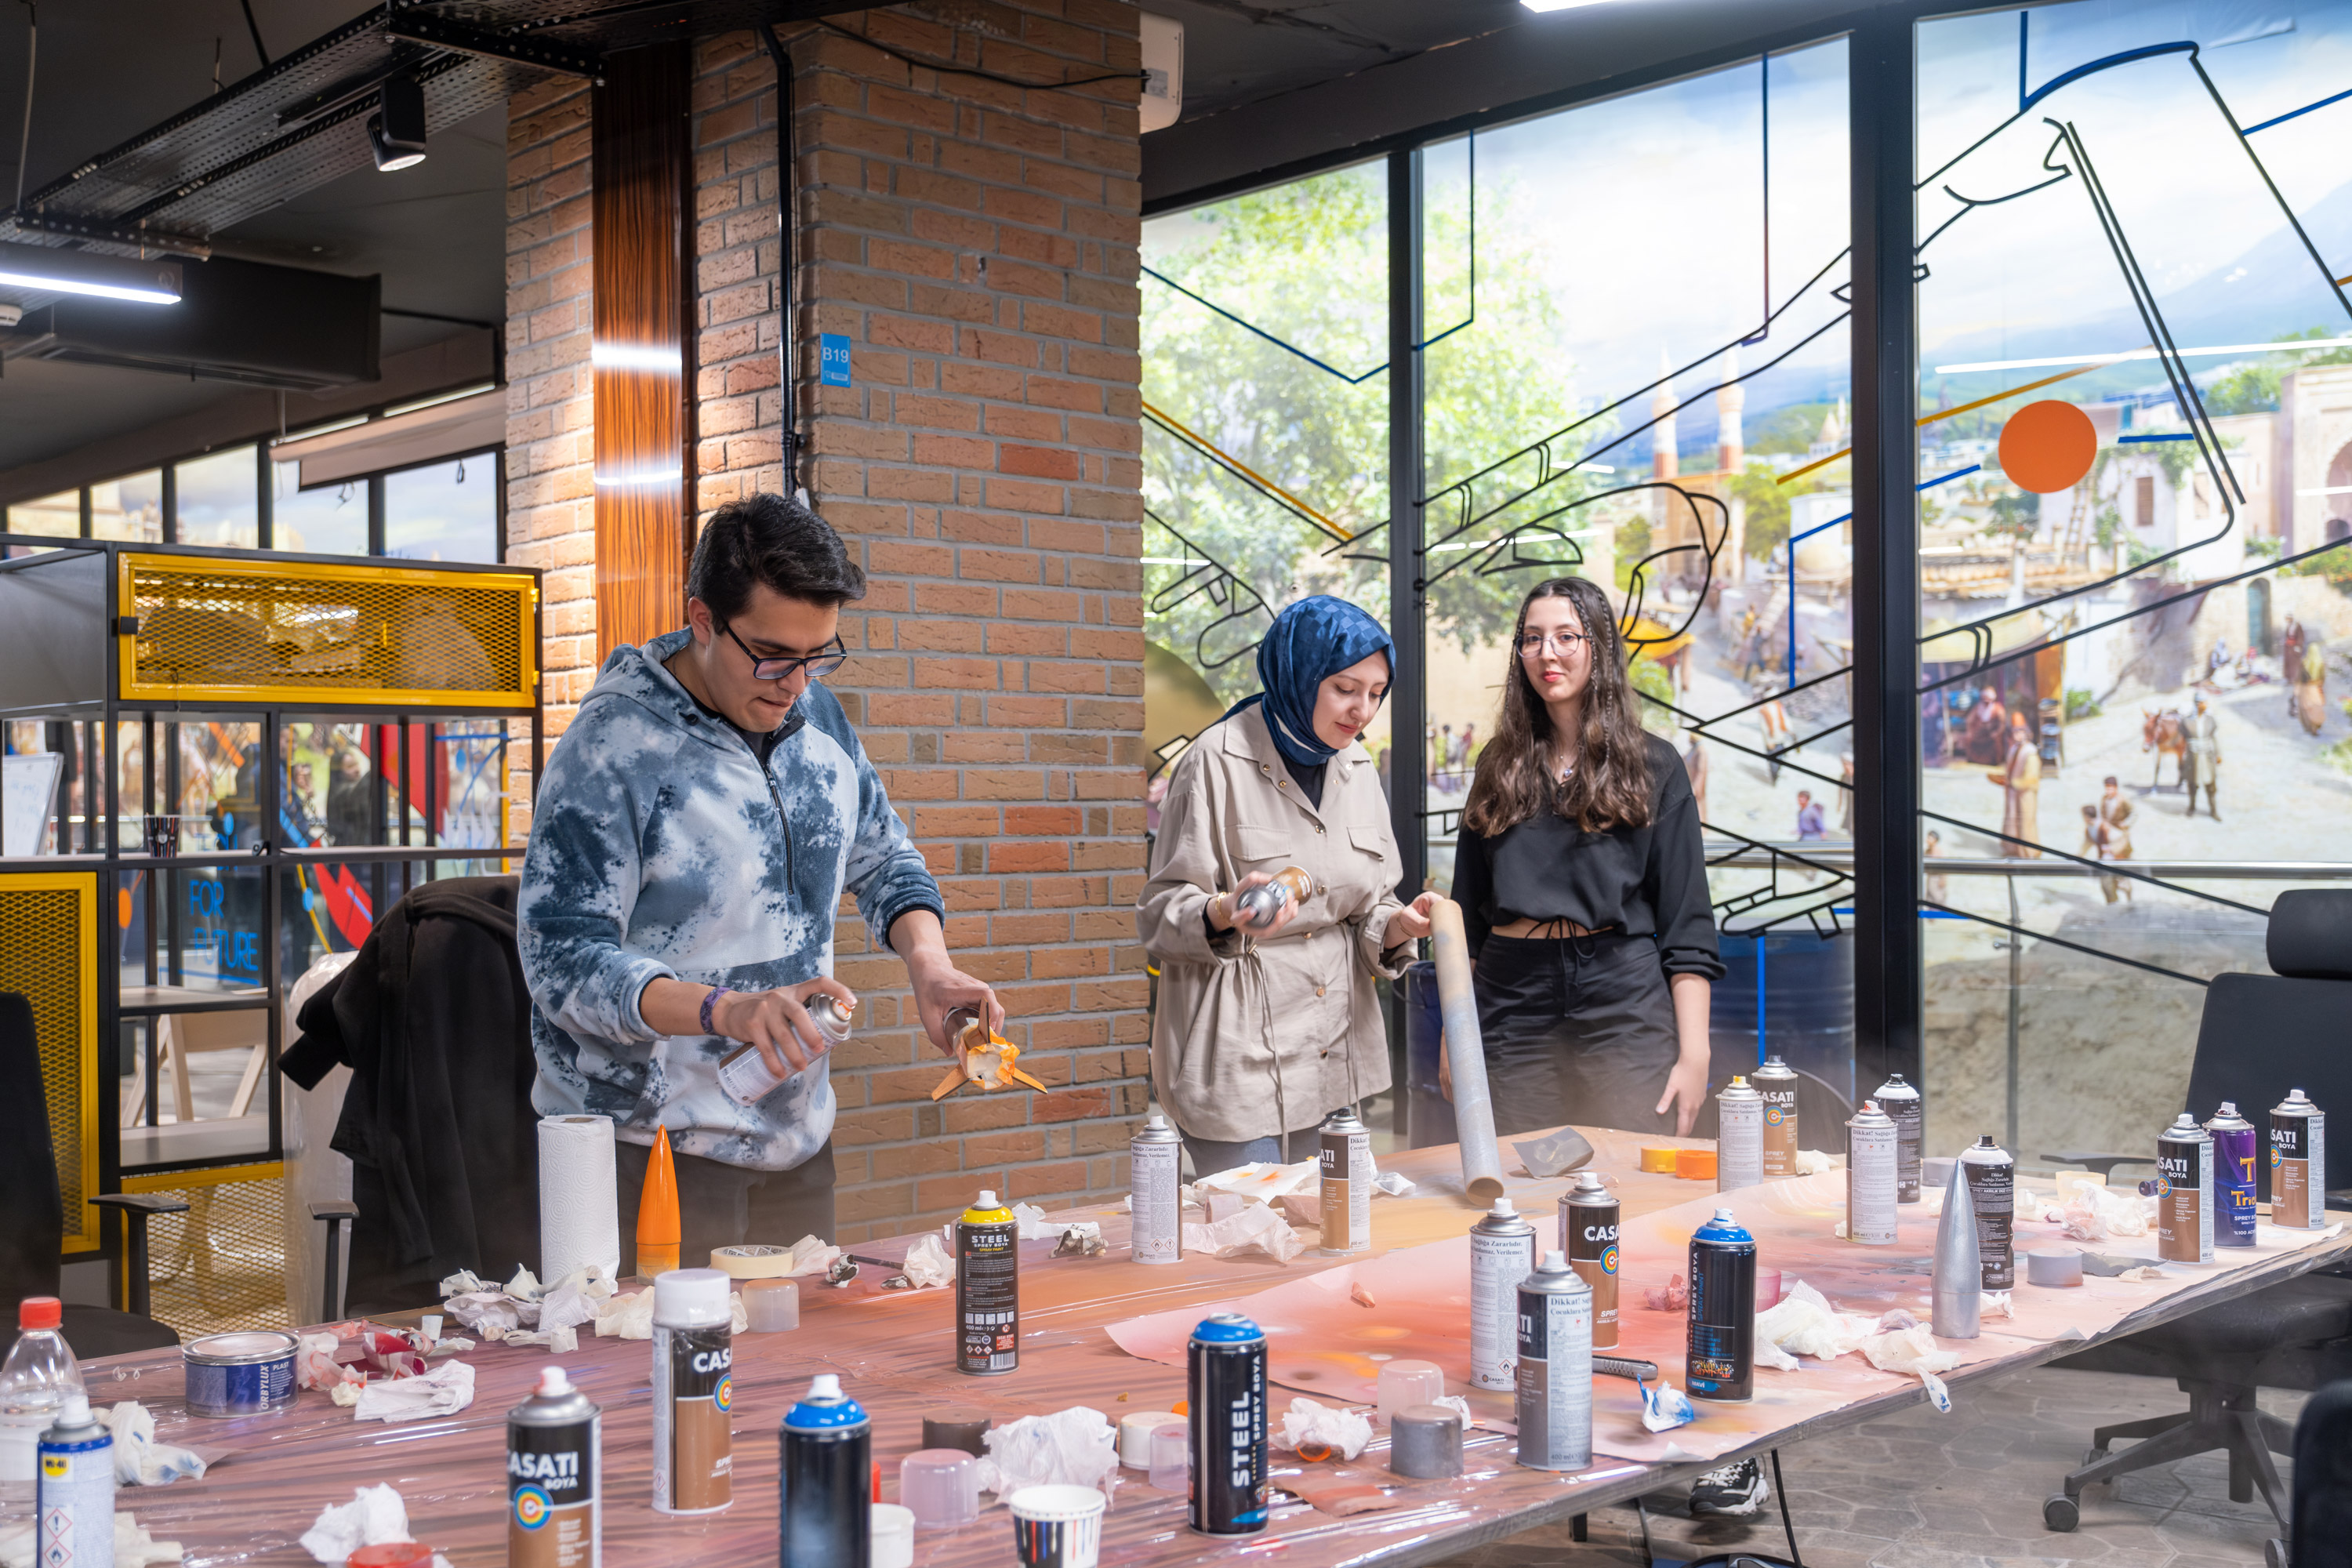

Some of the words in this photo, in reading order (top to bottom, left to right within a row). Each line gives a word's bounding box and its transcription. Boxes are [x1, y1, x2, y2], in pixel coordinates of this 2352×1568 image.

[822, 347, 849, 363] B19
[189, 880, 224, 920] FOR
[194, 927, 259, 971] FUTURE
[1319, 1148, 1335, 1162] ATI
[2158, 1156, 2187, 1172] SATI
[2240, 1156, 2256, 1182] T
[971, 1235, 1010, 1243] STEEL
[1551, 1297, 1581, 1306] Dikkat!
[273, 1361, 289, 1371] PLAST
[260, 1365, 270, 1410] ORBYLUX
[1232, 1391, 1250, 1487] STEEL
[508, 1451, 579, 1479] ASATI
[543, 1476, 579, 1490] BOYA
